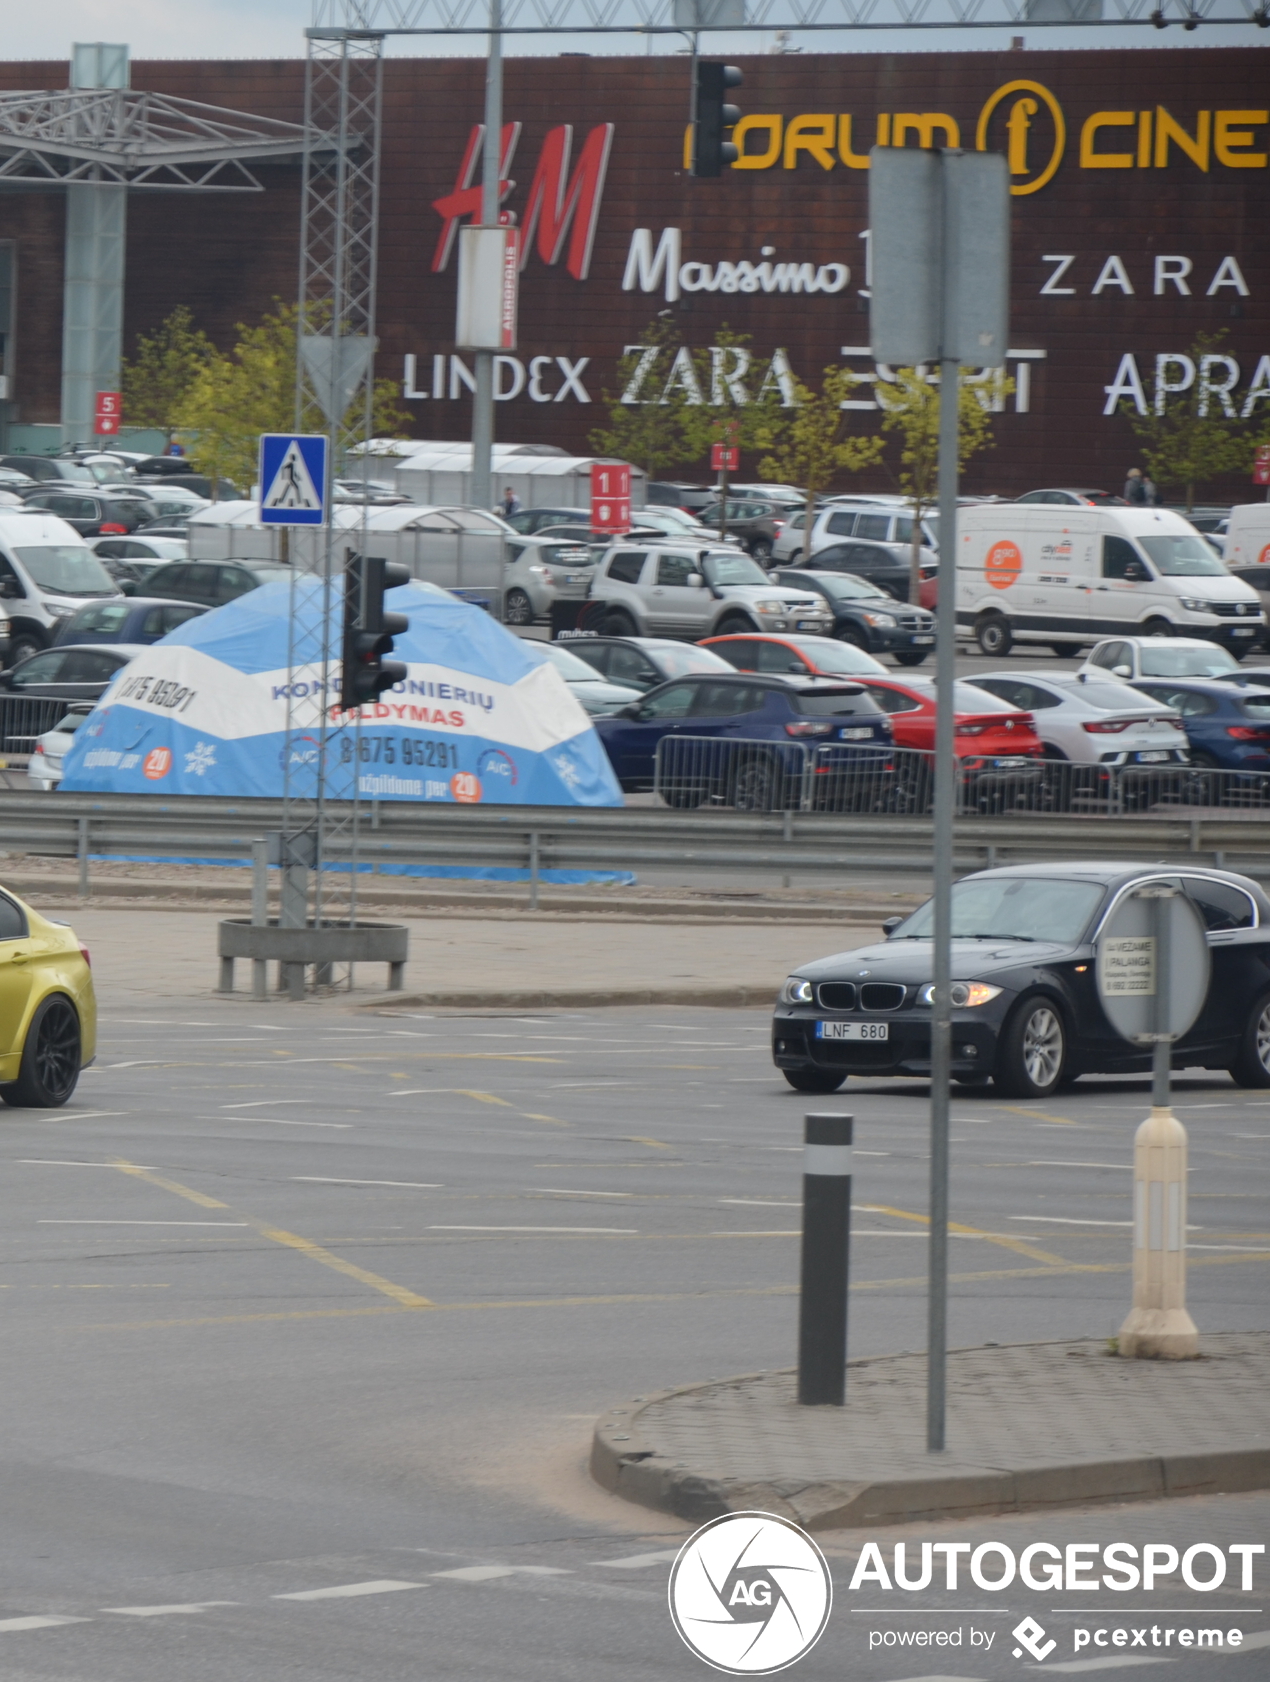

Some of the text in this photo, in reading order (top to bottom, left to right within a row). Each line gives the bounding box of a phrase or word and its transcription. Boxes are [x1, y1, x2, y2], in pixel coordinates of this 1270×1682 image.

[431, 121, 616, 281] HM
[622, 227, 851, 302] Massimo
[1039, 255, 1251, 296] ZARA
[502, 246, 516, 330] AKROPOLIS
[404, 353, 592, 404] LINDEX
[620, 345, 802, 408] ZARA
[102, 397, 115, 412] 5
[599, 473, 610, 493] 1
[330, 701, 465, 727] PILDYMAS
[146, 749, 168, 771] 20
[341, 736, 459, 769] 8 675 95291
[425, 779, 448, 798] per
[455, 773, 476, 796] 20
[824, 1023, 886, 1038] LNF 680
